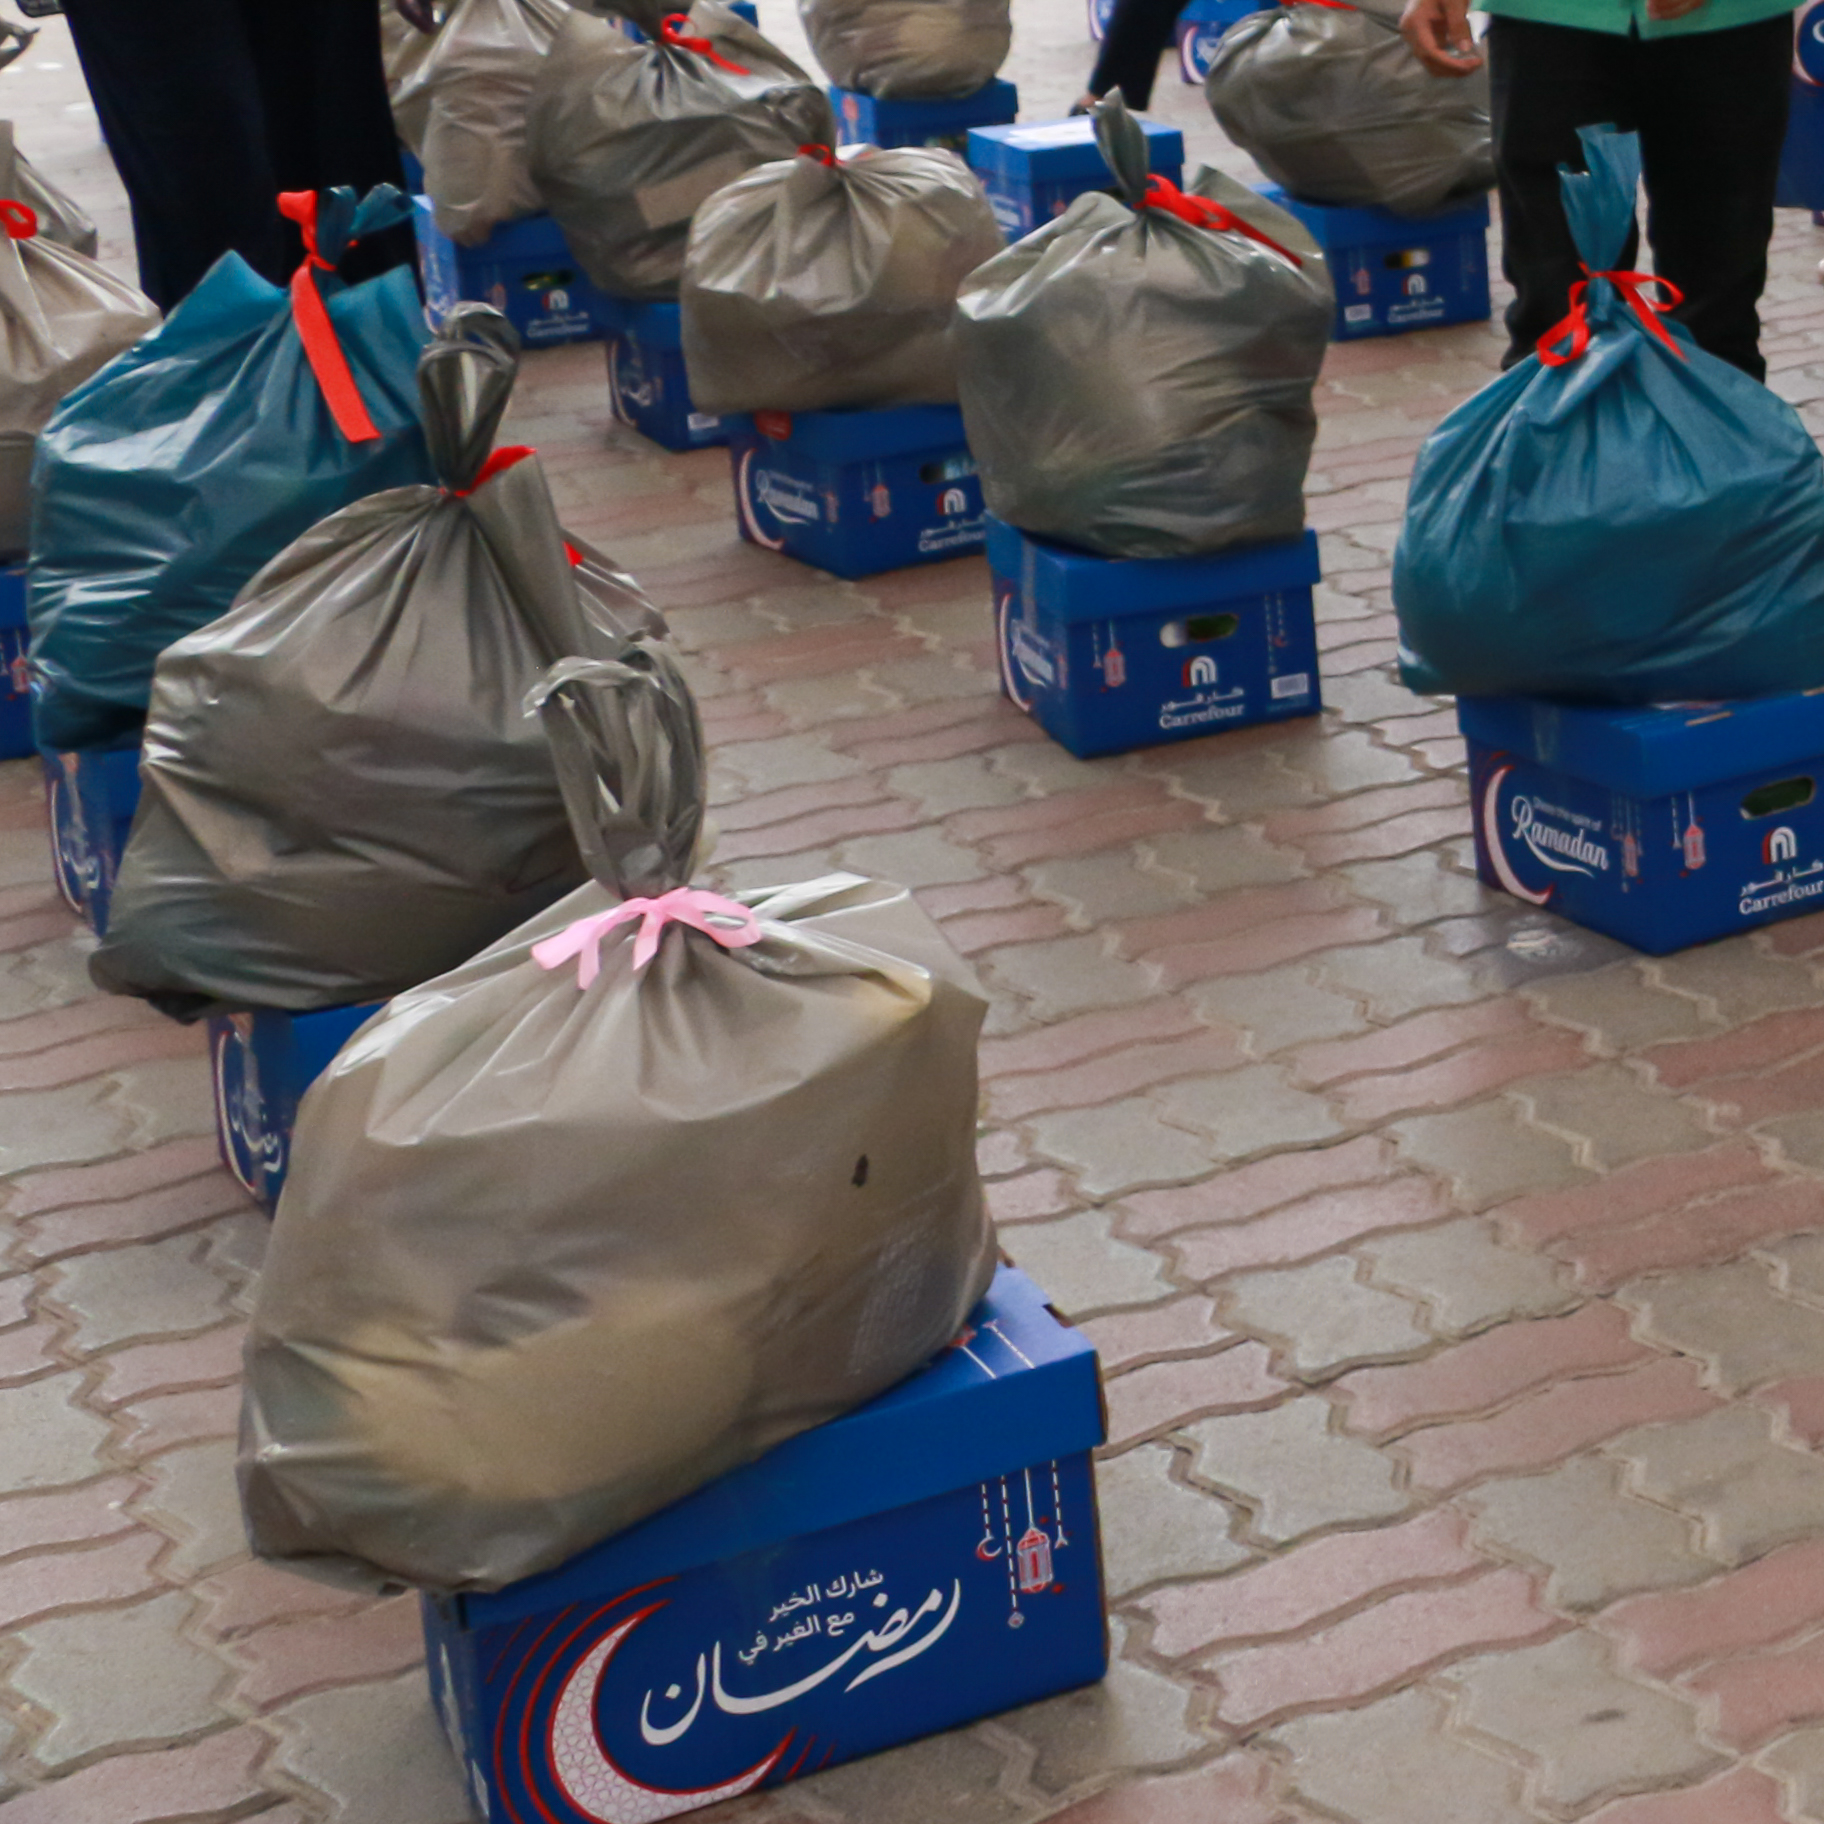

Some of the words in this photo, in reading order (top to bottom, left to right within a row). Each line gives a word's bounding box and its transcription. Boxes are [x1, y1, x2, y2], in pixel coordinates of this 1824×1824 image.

[1159, 704, 1246, 729] Carrefour
[1511, 795, 1608, 879] Ramadan
[769, 1583, 821, 1622] الخير
[825, 1569, 884, 1599] شارك
[773, 1614, 821, 1652] الغير
[827, 1612, 855, 1636] مع
[640, 1578, 961, 1746] رمضان
[738, 1629, 768, 1666] في
